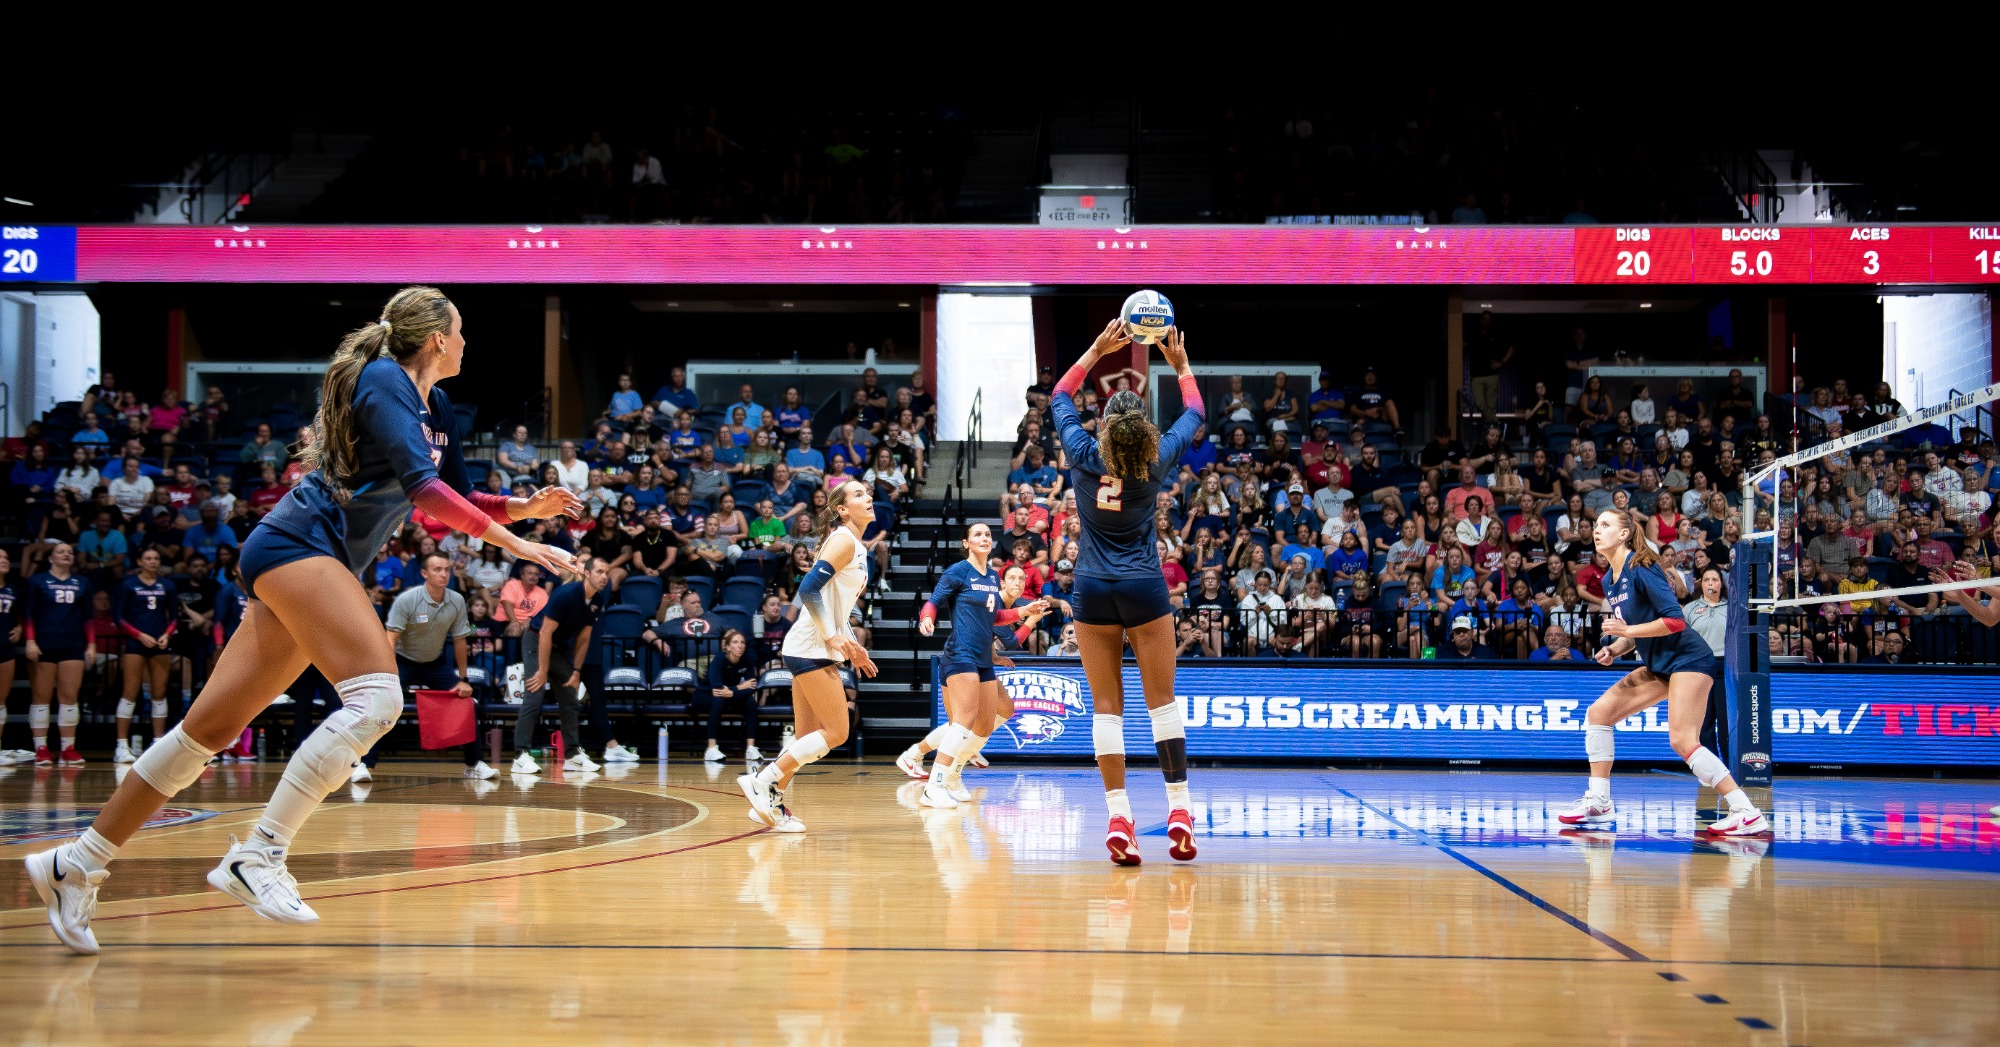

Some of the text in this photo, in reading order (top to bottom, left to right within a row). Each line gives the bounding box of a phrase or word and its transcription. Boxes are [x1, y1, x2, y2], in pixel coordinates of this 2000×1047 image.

[2, 227, 39, 240] DIGS
[1616, 227, 1651, 242] DIGS
[1721, 227, 1781, 241] BLOCKS
[1849, 227, 1890, 241] ACES
[214, 239, 266, 248] BANK
[508, 240, 559, 249] BANK
[802, 240, 853, 249] BANK
[1097, 241, 1148, 249] BANK
[1396, 241, 1447, 249] BANK
[2, 249, 38, 273] 20
[1616, 250, 1651, 276] 20
[1730, 250, 1773, 276] 5.0
[1863, 250, 1880, 275] 3
[1138, 305, 1168, 315] molten
[1096, 474, 1123, 512] 2
[55, 589, 75, 604] 20
[147, 596, 158, 610] 3
[986, 592, 996, 613] 4
[997, 673, 1080, 695] THERN
[1750, 685, 1760, 744] sports imports
